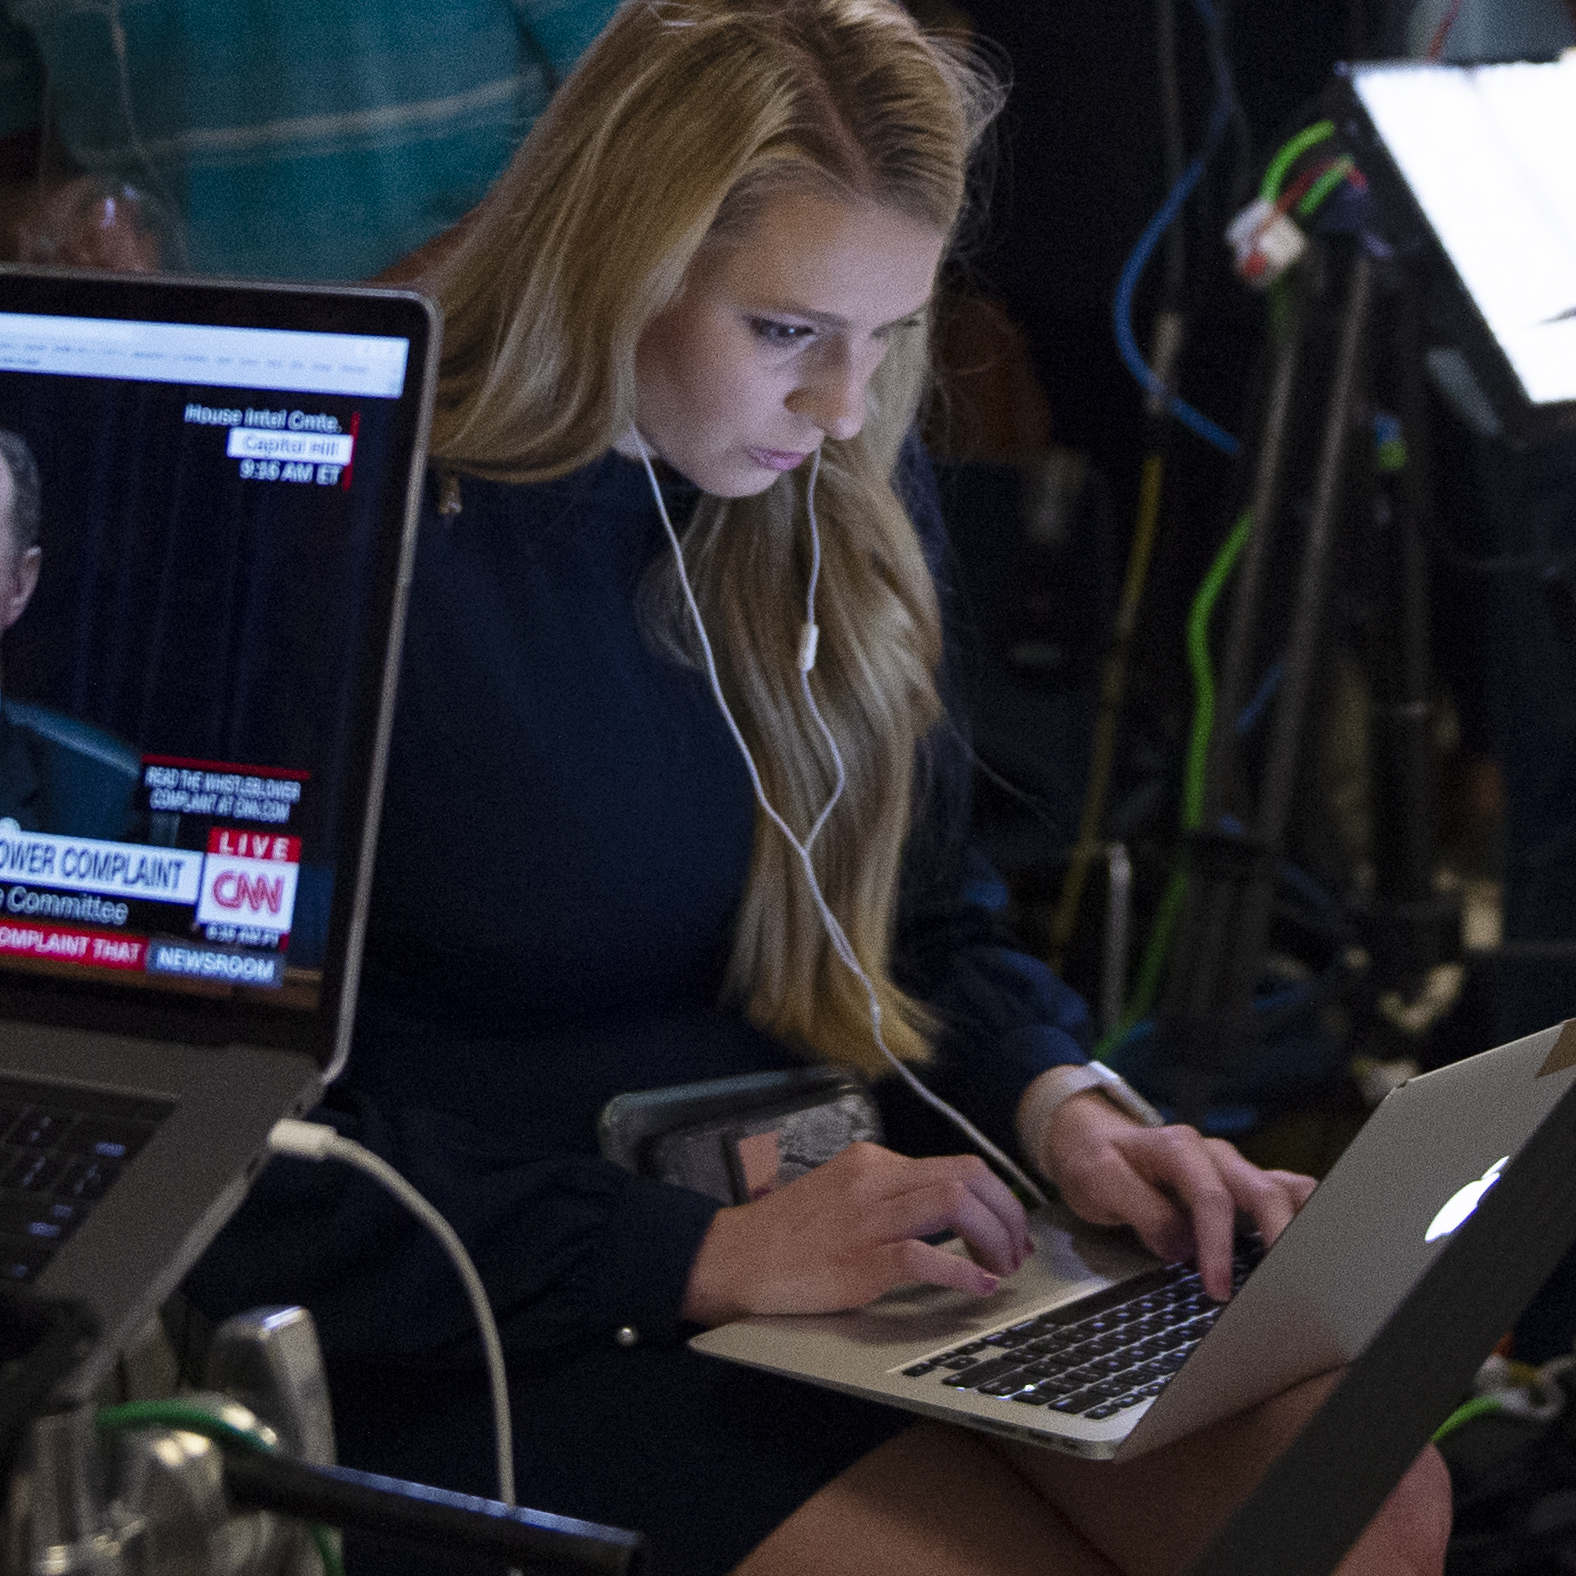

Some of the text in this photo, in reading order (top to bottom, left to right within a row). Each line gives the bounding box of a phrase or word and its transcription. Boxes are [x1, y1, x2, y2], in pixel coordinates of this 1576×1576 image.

[184, 403, 243, 426] House
[244, 407, 287, 429] Intel
[243, 434, 303, 455] Capitol
[281, 462, 314, 484] AM
[316, 464, 343, 486] ET
[218, 831, 290, 862] LIVE
[61, 845, 185, 890] COMPLAINT
[7, 885, 129, 925] Committee
[213, 870, 284, 914] CNN
[92, 938, 143, 963] THAT
[157, 947, 275, 982] NEWSROOM
